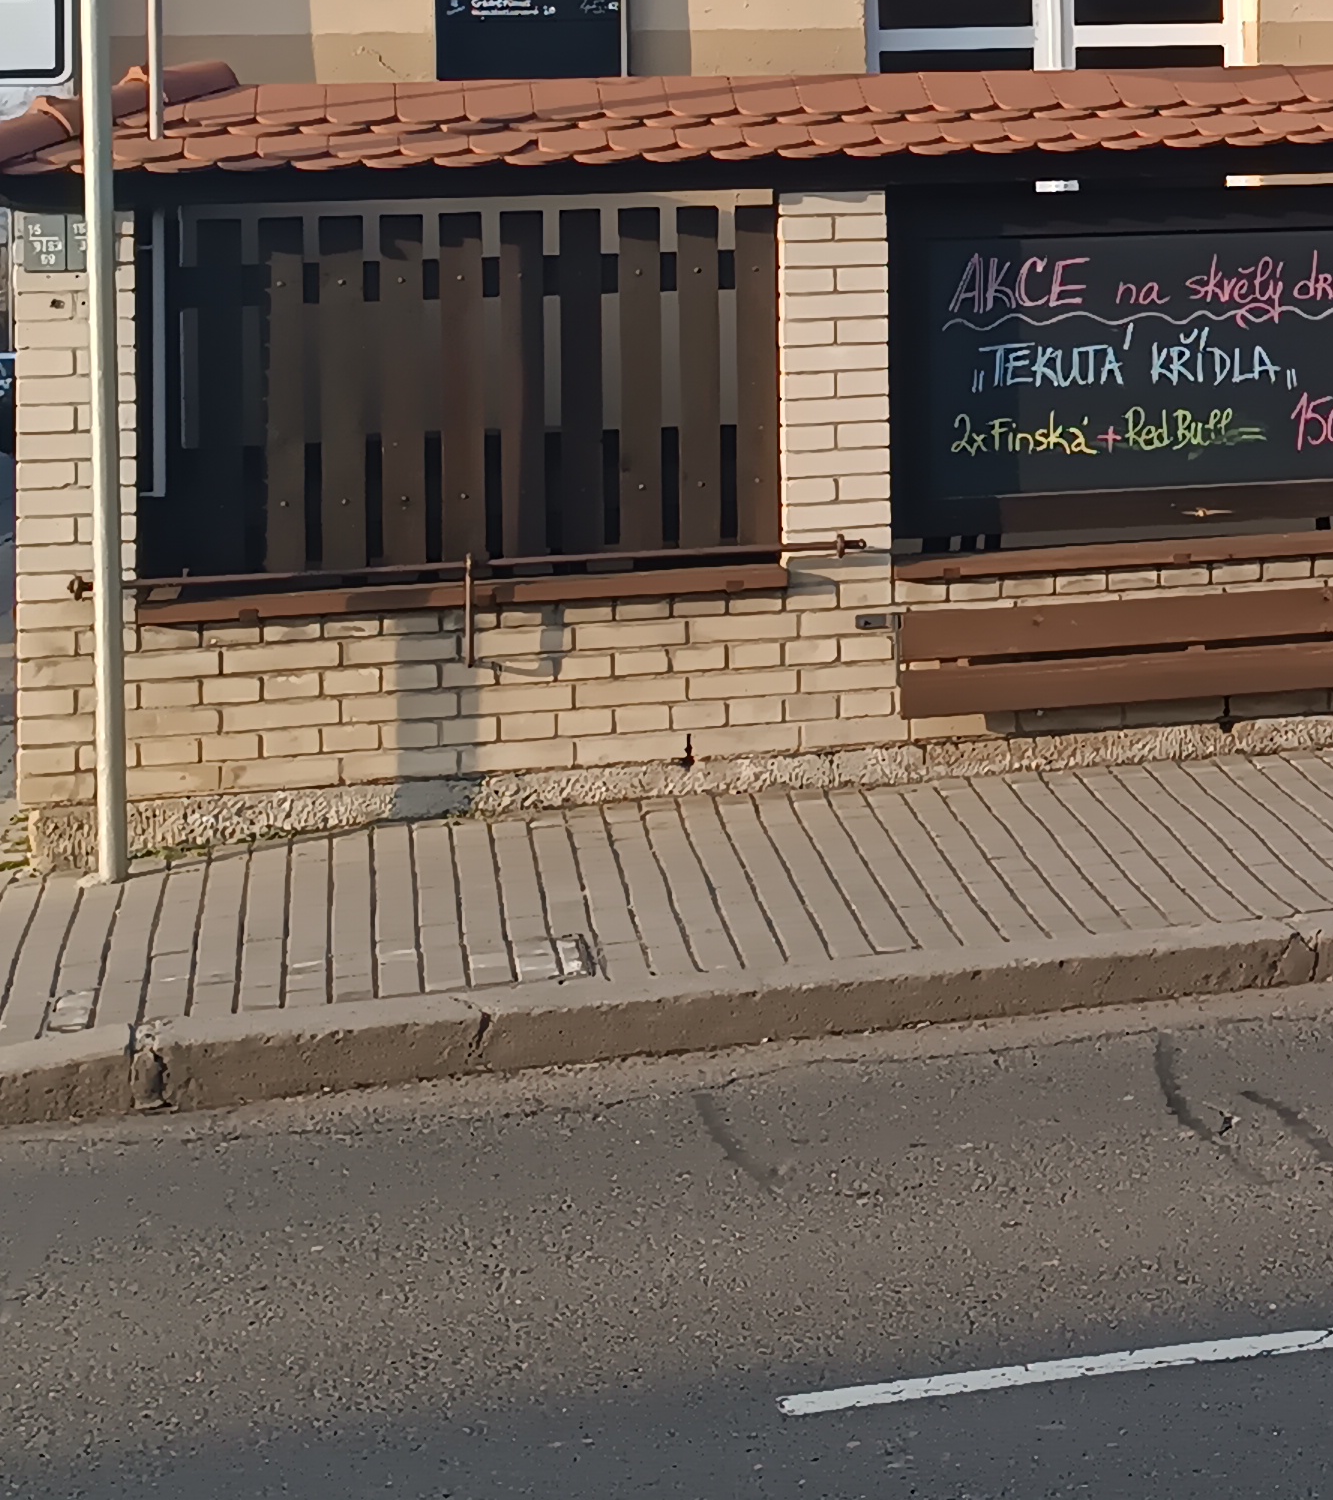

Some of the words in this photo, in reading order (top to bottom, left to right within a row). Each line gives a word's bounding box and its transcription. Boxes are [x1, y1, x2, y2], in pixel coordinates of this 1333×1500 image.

[949, 252, 1091, 314] AKCE
[1116, 281, 1171, 305] na
[1185, 253, 1284, 330] skvělý
